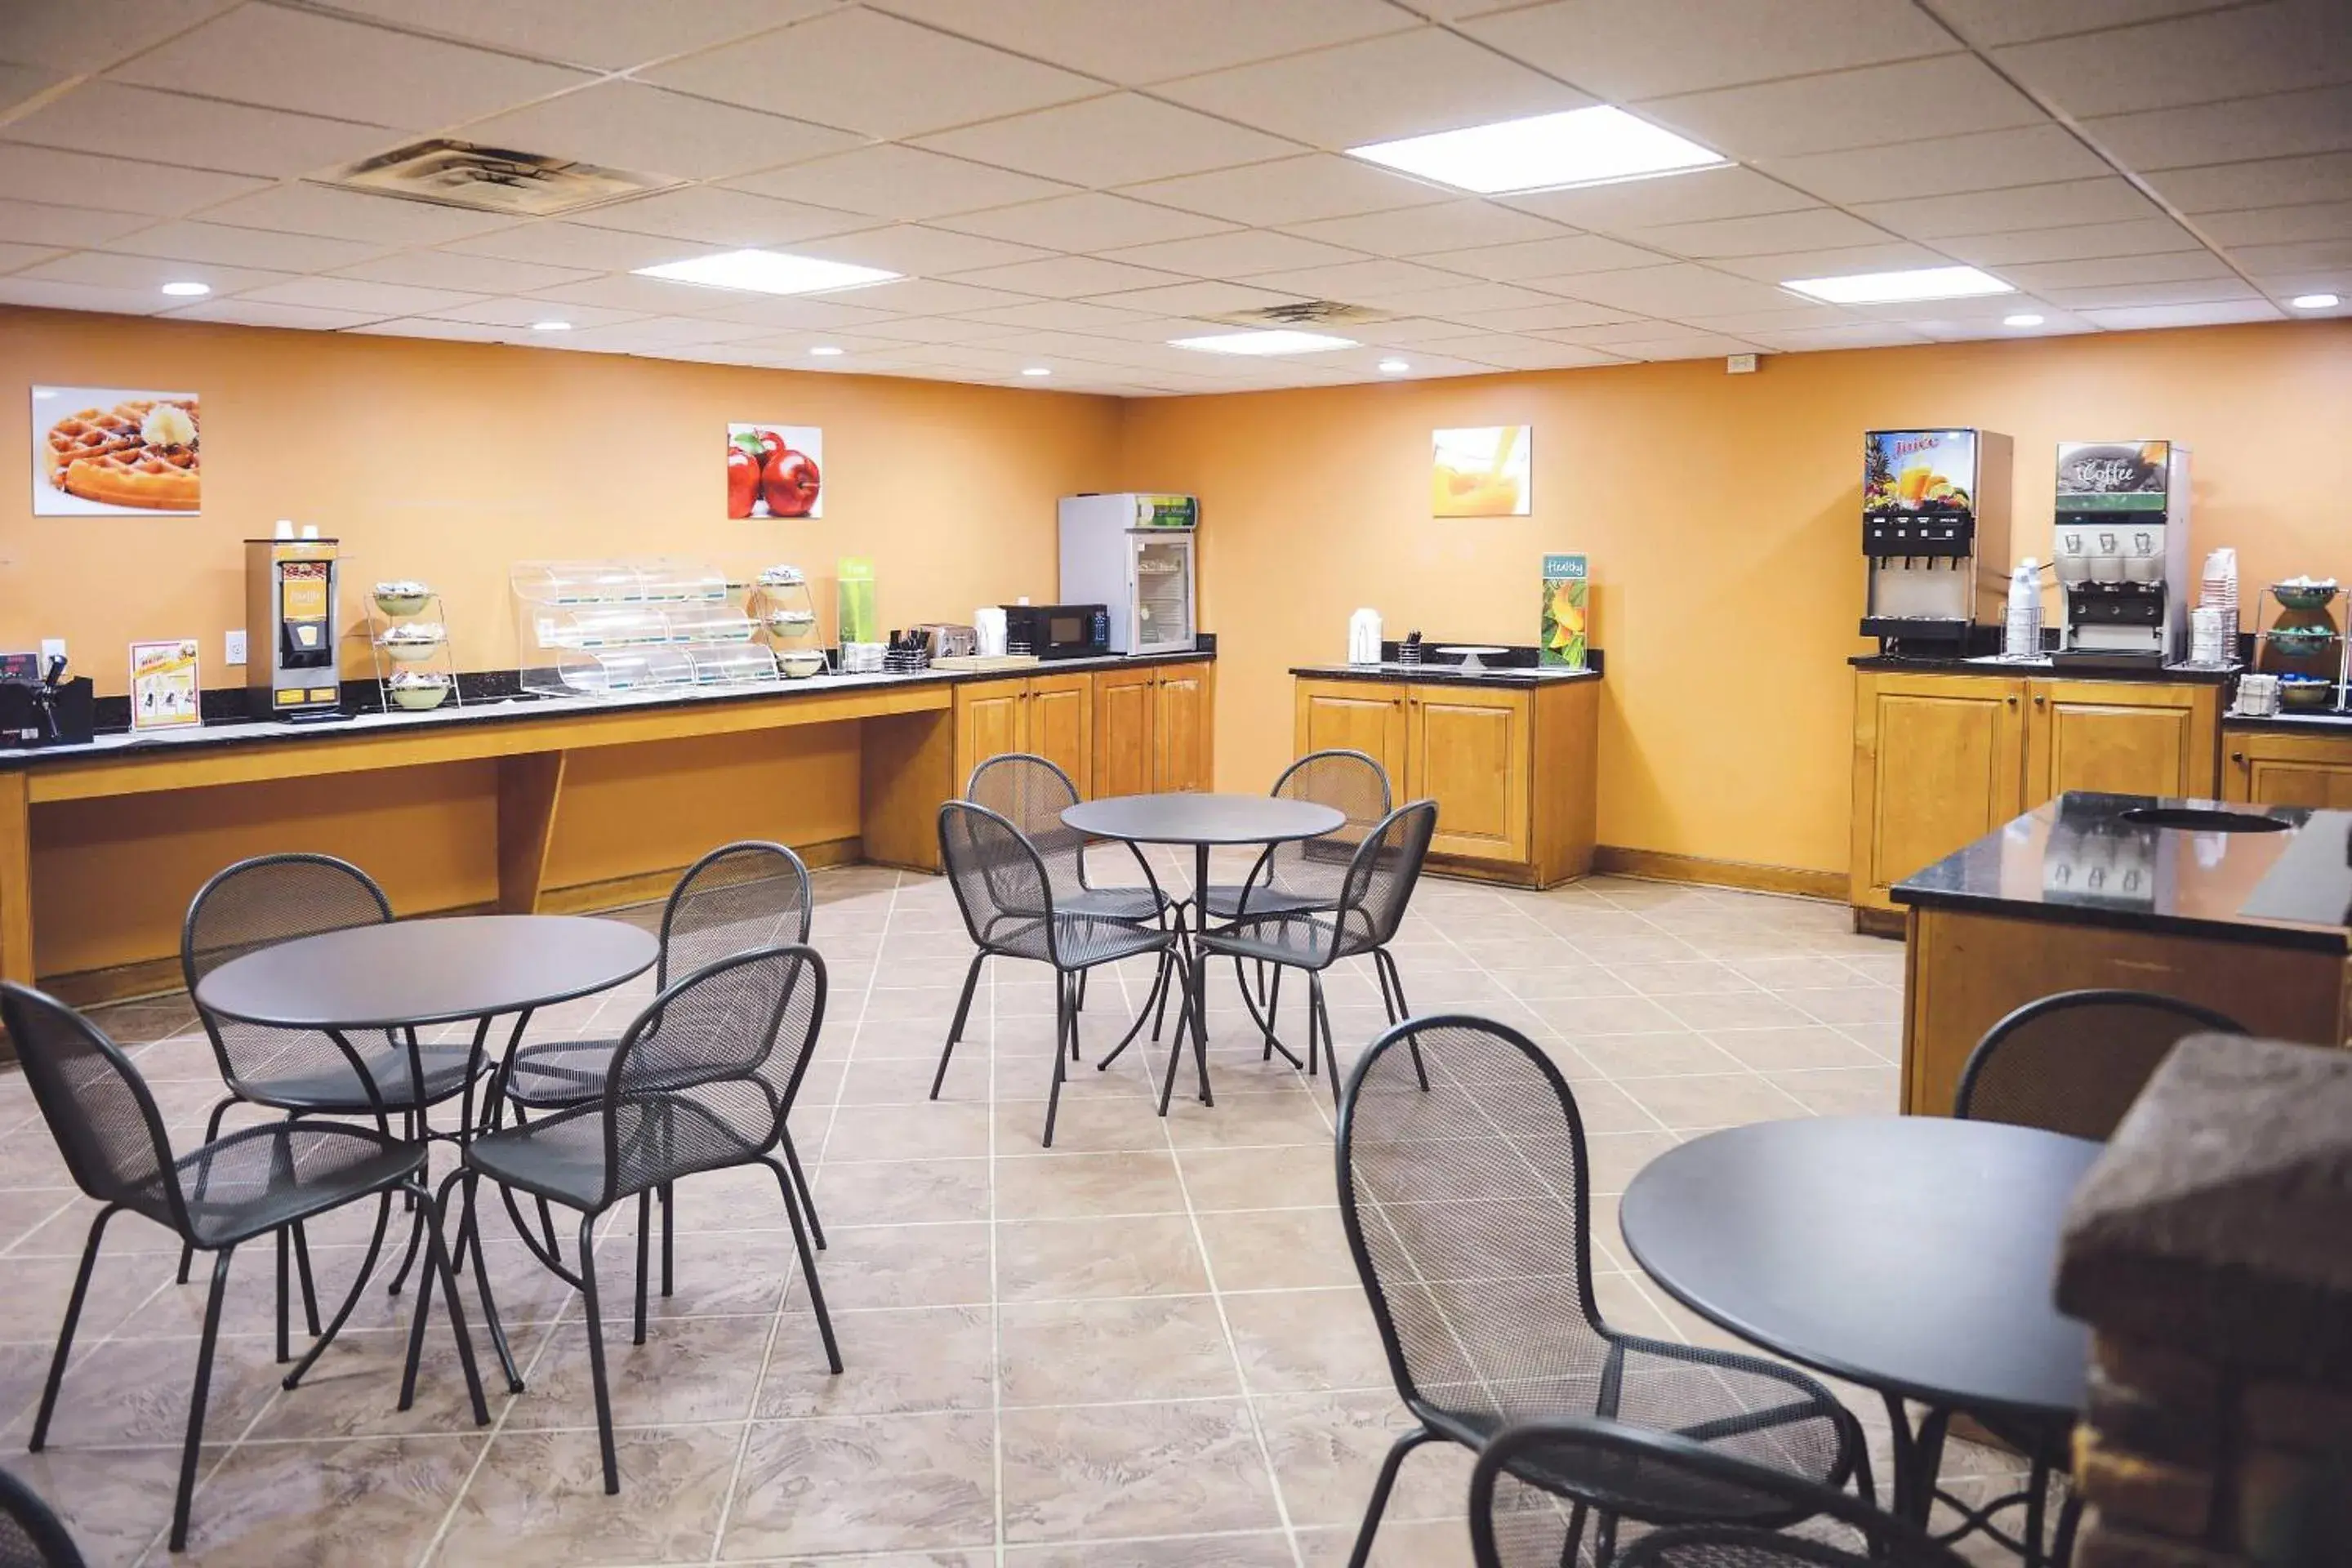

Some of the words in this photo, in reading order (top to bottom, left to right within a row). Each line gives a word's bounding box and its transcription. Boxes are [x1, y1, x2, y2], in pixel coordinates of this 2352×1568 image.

[1895, 438, 1939, 456] Juice
[2079, 461, 2134, 485] Coffee
[1547, 560, 1583, 576] Healthy
